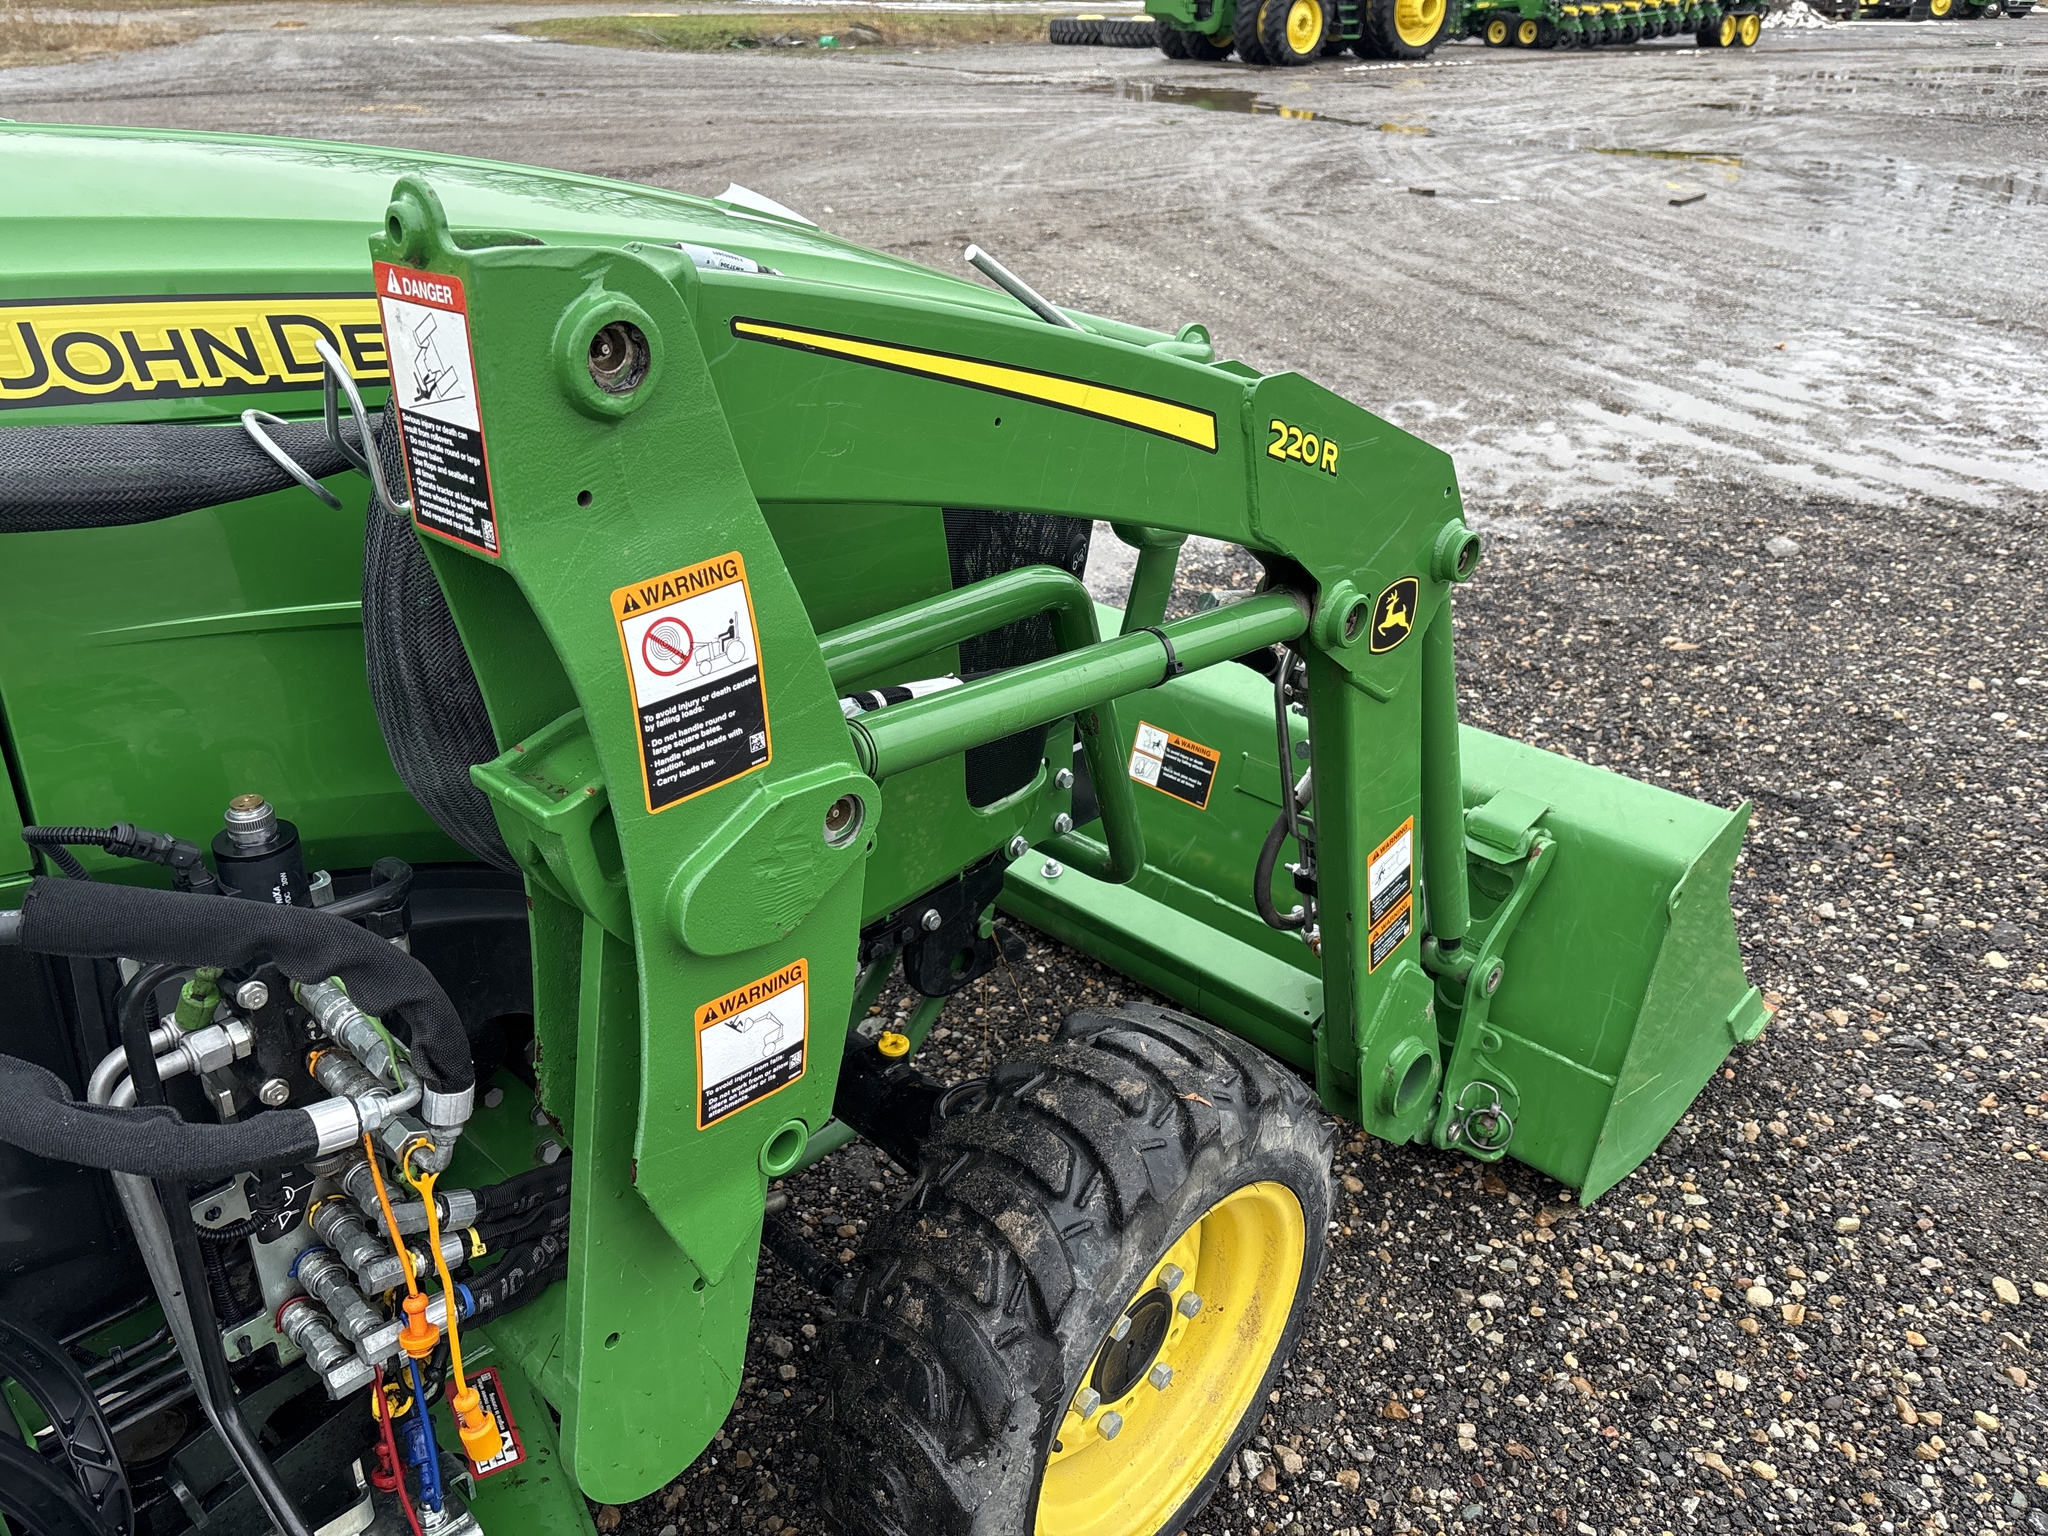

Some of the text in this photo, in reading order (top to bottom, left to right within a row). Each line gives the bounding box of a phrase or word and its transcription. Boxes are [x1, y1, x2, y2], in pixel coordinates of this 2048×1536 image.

[402, 277, 453, 305] DANGER
[0, 321, 266, 390] JOHN
[402, 412, 420, 425] Serious
[421, 418, 435, 431] injury
[442, 426, 457, 437] death
[458, 431, 468, 440] can
[404, 425, 454, 446] result from rollovers.
[410, 435, 417, 445] Do
[418, 439, 426, 448] not
[427, 441, 443, 453] handle
[445, 448, 459, 458] round
[467, 453, 480, 466] large
[412, 448, 444, 464] square bales.
[1266, 418, 1339, 477] 220R
[413, 456, 423, 466] Use
[424, 460, 436, 471] Rops
[438, 466, 447, 475] and
[448, 470, 468, 482] seatbelt
[422, 469, 437, 481] times.
[417, 477, 436, 491] Operate
[437, 485, 453, 496] tractor
[461, 493, 470, 503] low
[471, 498, 488, 510] speed.
[418, 488, 474, 515] Move wheels to widest
[420, 499, 454, 517] recommended
[422, 508, 431, 518] Add
[432, 513, 452, 526] required
[453, 521, 463, 530] rear
[639, 559, 738, 606] WARNING
[656, 706, 676, 719] avoid
[678, 698, 700, 711] injury
[711, 686, 731, 699] death
[733, 675, 757, 690] caused
[645, 705, 705, 733] by falling loads:
[651, 738, 662, 747] Do
[664, 732, 677, 742] not
[678, 724, 704, 737] handle
[705, 714, 727, 726] round
[652, 725, 722, 755] large square bales.
[654, 728, 743, 767] Handle raised loads with
[1181, 740, 1211, 757] WARNING
[656, 761, 686, 776] caution.
[657, 759, 716, 786] Carry loads low.
[1380, 824, 1408, 854] WARNING
[1381, 902, 1408, 930] WARNING
[720, 966, 801, 1015] WARNING
[715, 1080, 733, 1092] avoid
[735, 1070, 753, 1082] injury
[754, 1063, 769, 1073] from
[720, 1091, 730, 1100] not
[732, 1082, 747, 1093] work
[748, 1075, 763, 1085] from
[773, 1061, 788, 1072] allow
[708, 1095, 749, 1118] attachments.
[709, 1098, 727, 1111] riders
[739, 1083, 759, 1096] loader
[489, 1392, 498, 1410] running
[496, 1415, 505, 1430] engine
